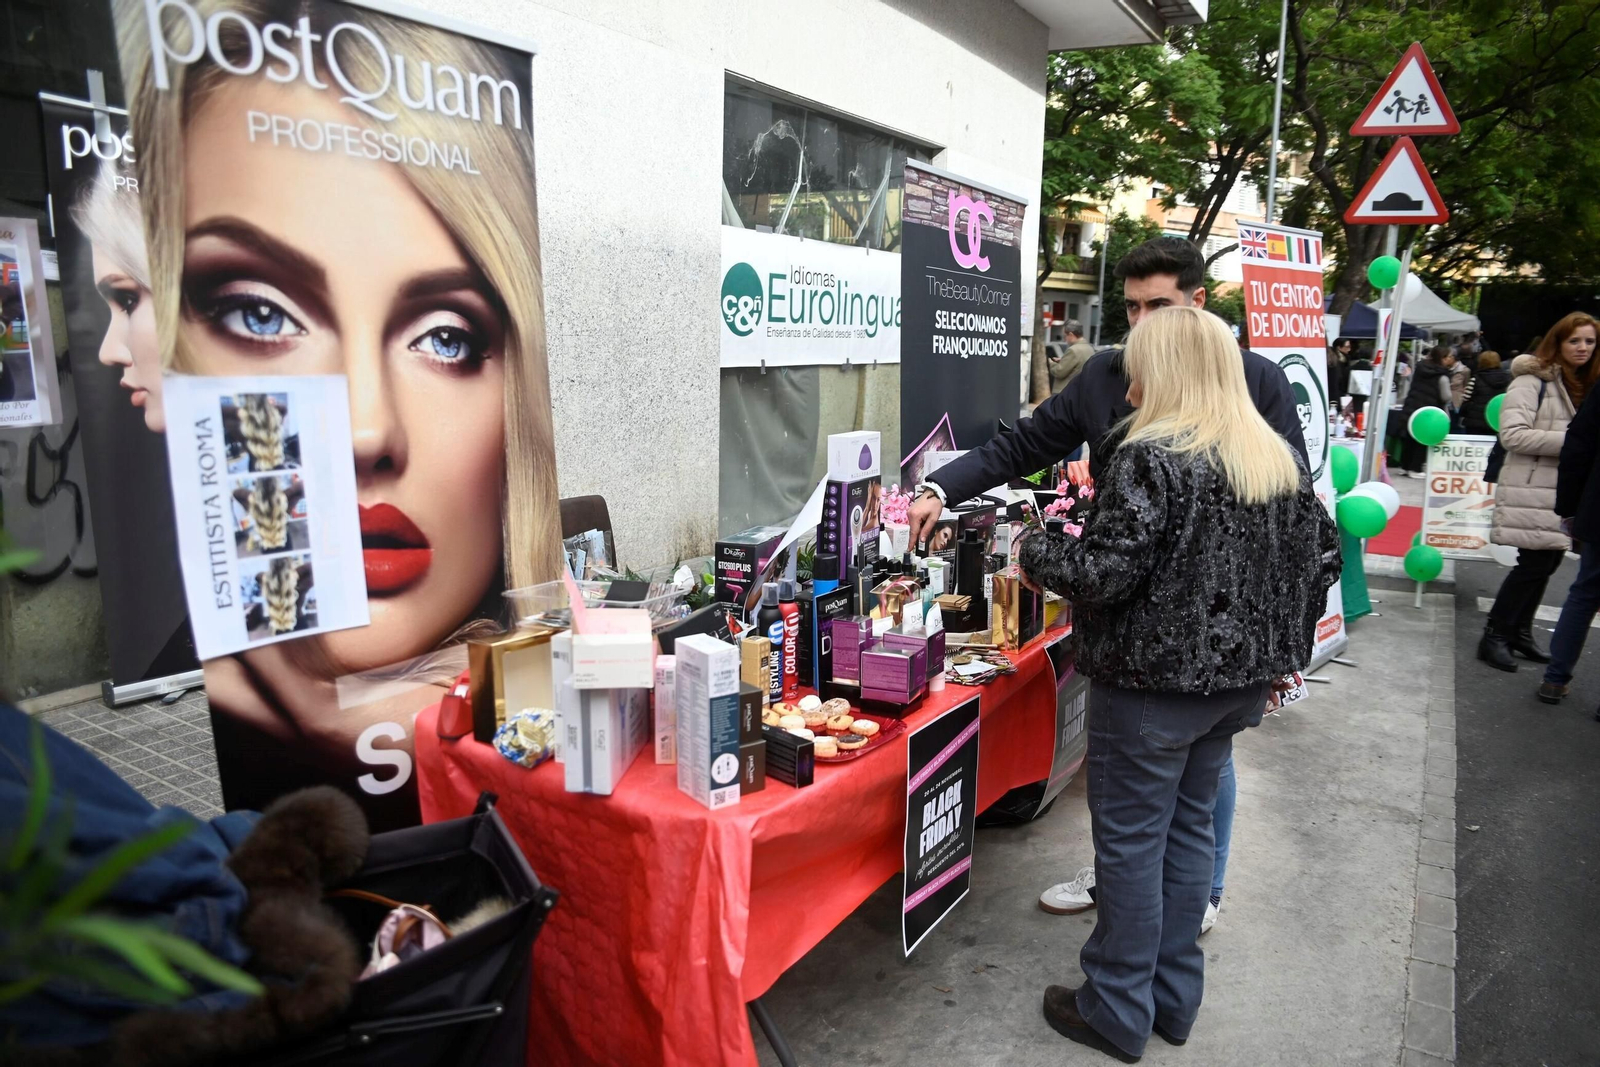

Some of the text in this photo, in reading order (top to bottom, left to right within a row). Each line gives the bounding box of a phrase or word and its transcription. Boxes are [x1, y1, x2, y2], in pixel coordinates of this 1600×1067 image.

[150, 0, 522, 129] postQuam
[247, 110, 481, 175] PROFESSIONAL
[790, 264, 836, 288] Idiomas
[1250, 280, 1322, 310] TU CENTRO
[766, 326, 801, 338] Enseñanza
[802, 328, 811, 338] de
[812, 328, 834, 339] Calidad
[835, 329, 852, 339] desde
[934, 309, 1007, 336] SELECIONAMOS
[1250, 311, 1326, 339] DE IDIOMAS
[932, 334, 1009, 359] FRANQUICIADOS
[194, 416, 233, 611] ESTITISTA ROMA
[1427, 535, 1480, 548] Cambridge
[735, 562, 752, 573] PLUS
[769, 650, 779, 690] STYLING
[784, 637, 796, 675] COLOR
[1064, 689, 1086, 727] BLACK
[1060, 710, 1086, 749] FRIDAY
[355, 721, 413, 796] S
[919, 765, 934, 780] FRIDAY
[933, 754, 946, 768] BLACK
[945, 741, 959, 756] FRIDAY
[957, 731, 969, 745] BLACK
[930, 785, 935, 793] AL
[941, 766, 963, 786] NOVIEMBRE
[922, 779, 963, 830] BLACK
[919, 802, 963, 859] FRIDAY
[927, 854, 950, 876] DESCUENTO
[949, 848, 957, 857] DEL
[915, 887, 928, 900] FRIDAY
[927, 880, 940, 892] BLACK
[950, 864, 961, 876] BLACK
